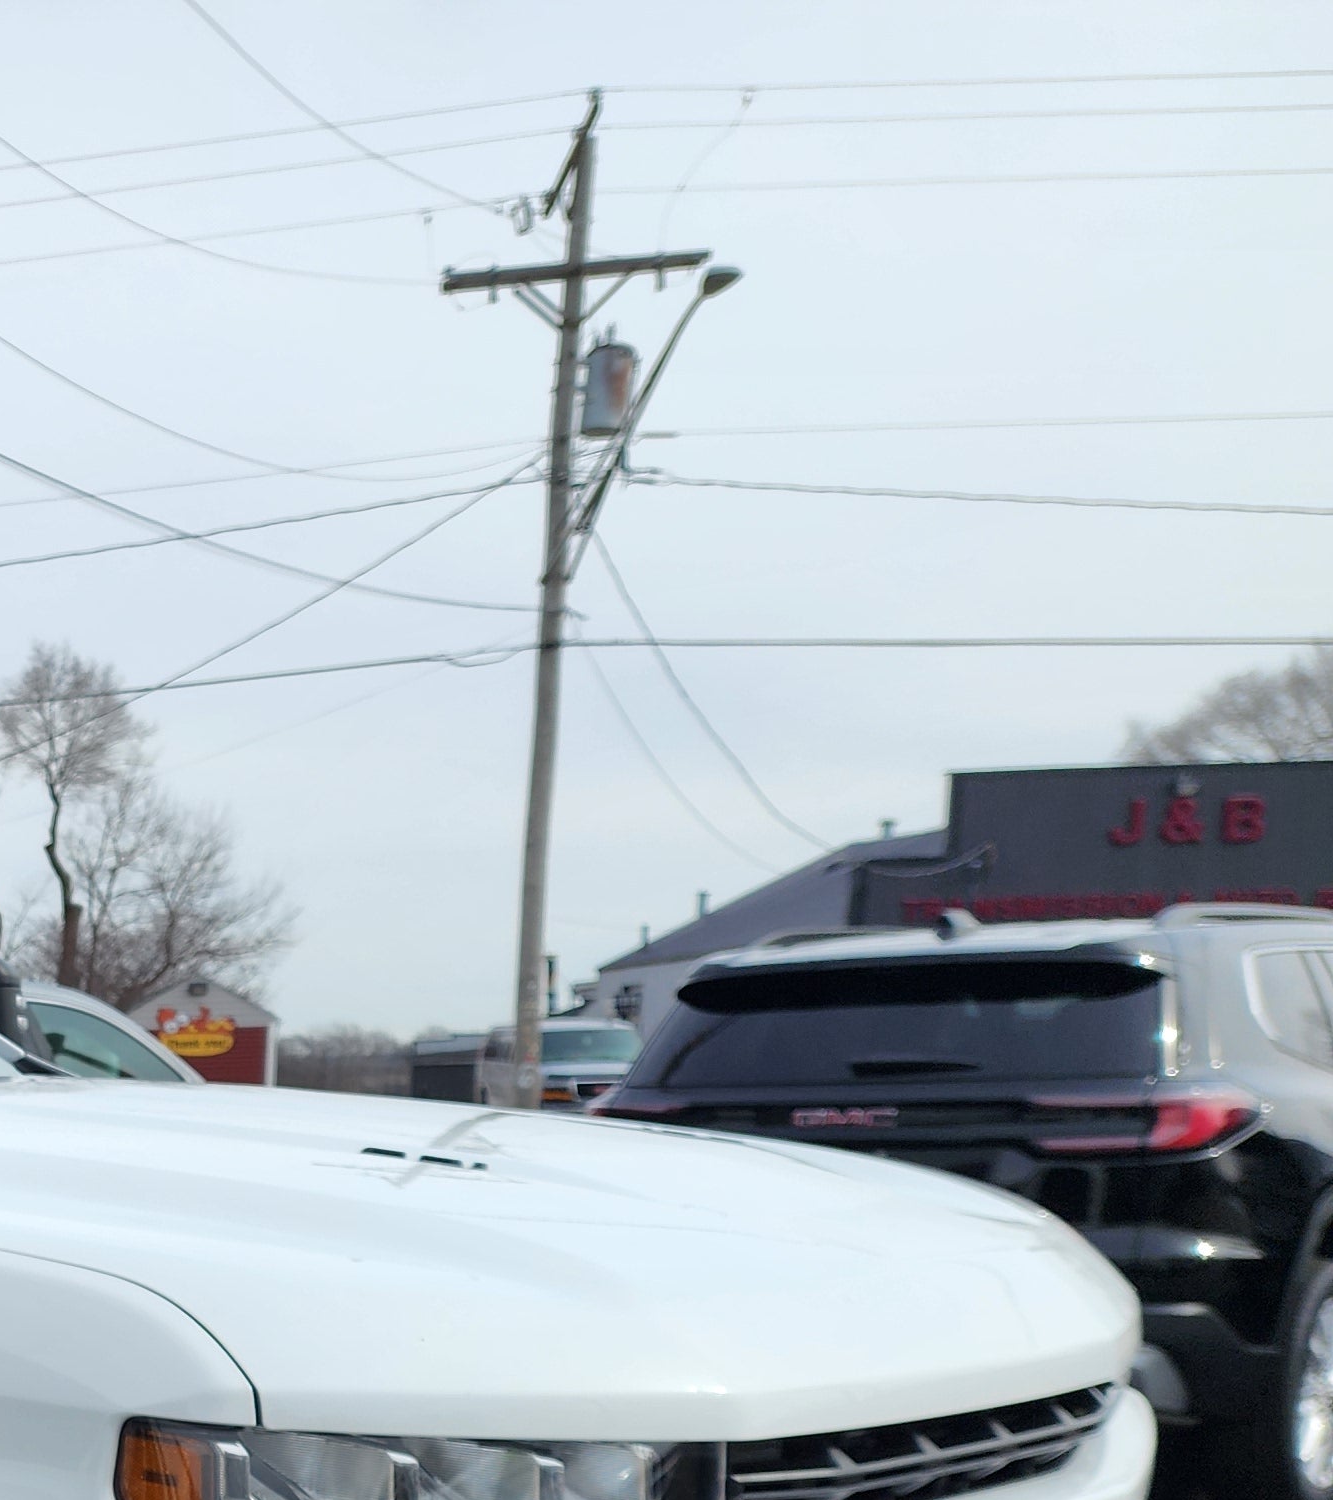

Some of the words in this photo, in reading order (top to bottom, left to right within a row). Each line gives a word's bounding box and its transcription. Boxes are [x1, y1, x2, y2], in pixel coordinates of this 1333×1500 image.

[1108, 797, 1147, 846] J
[1160, 797, 1204, 844] &
[1223, 793, 1267, 843] B
[791, 1107, 899, 1127] GMC
